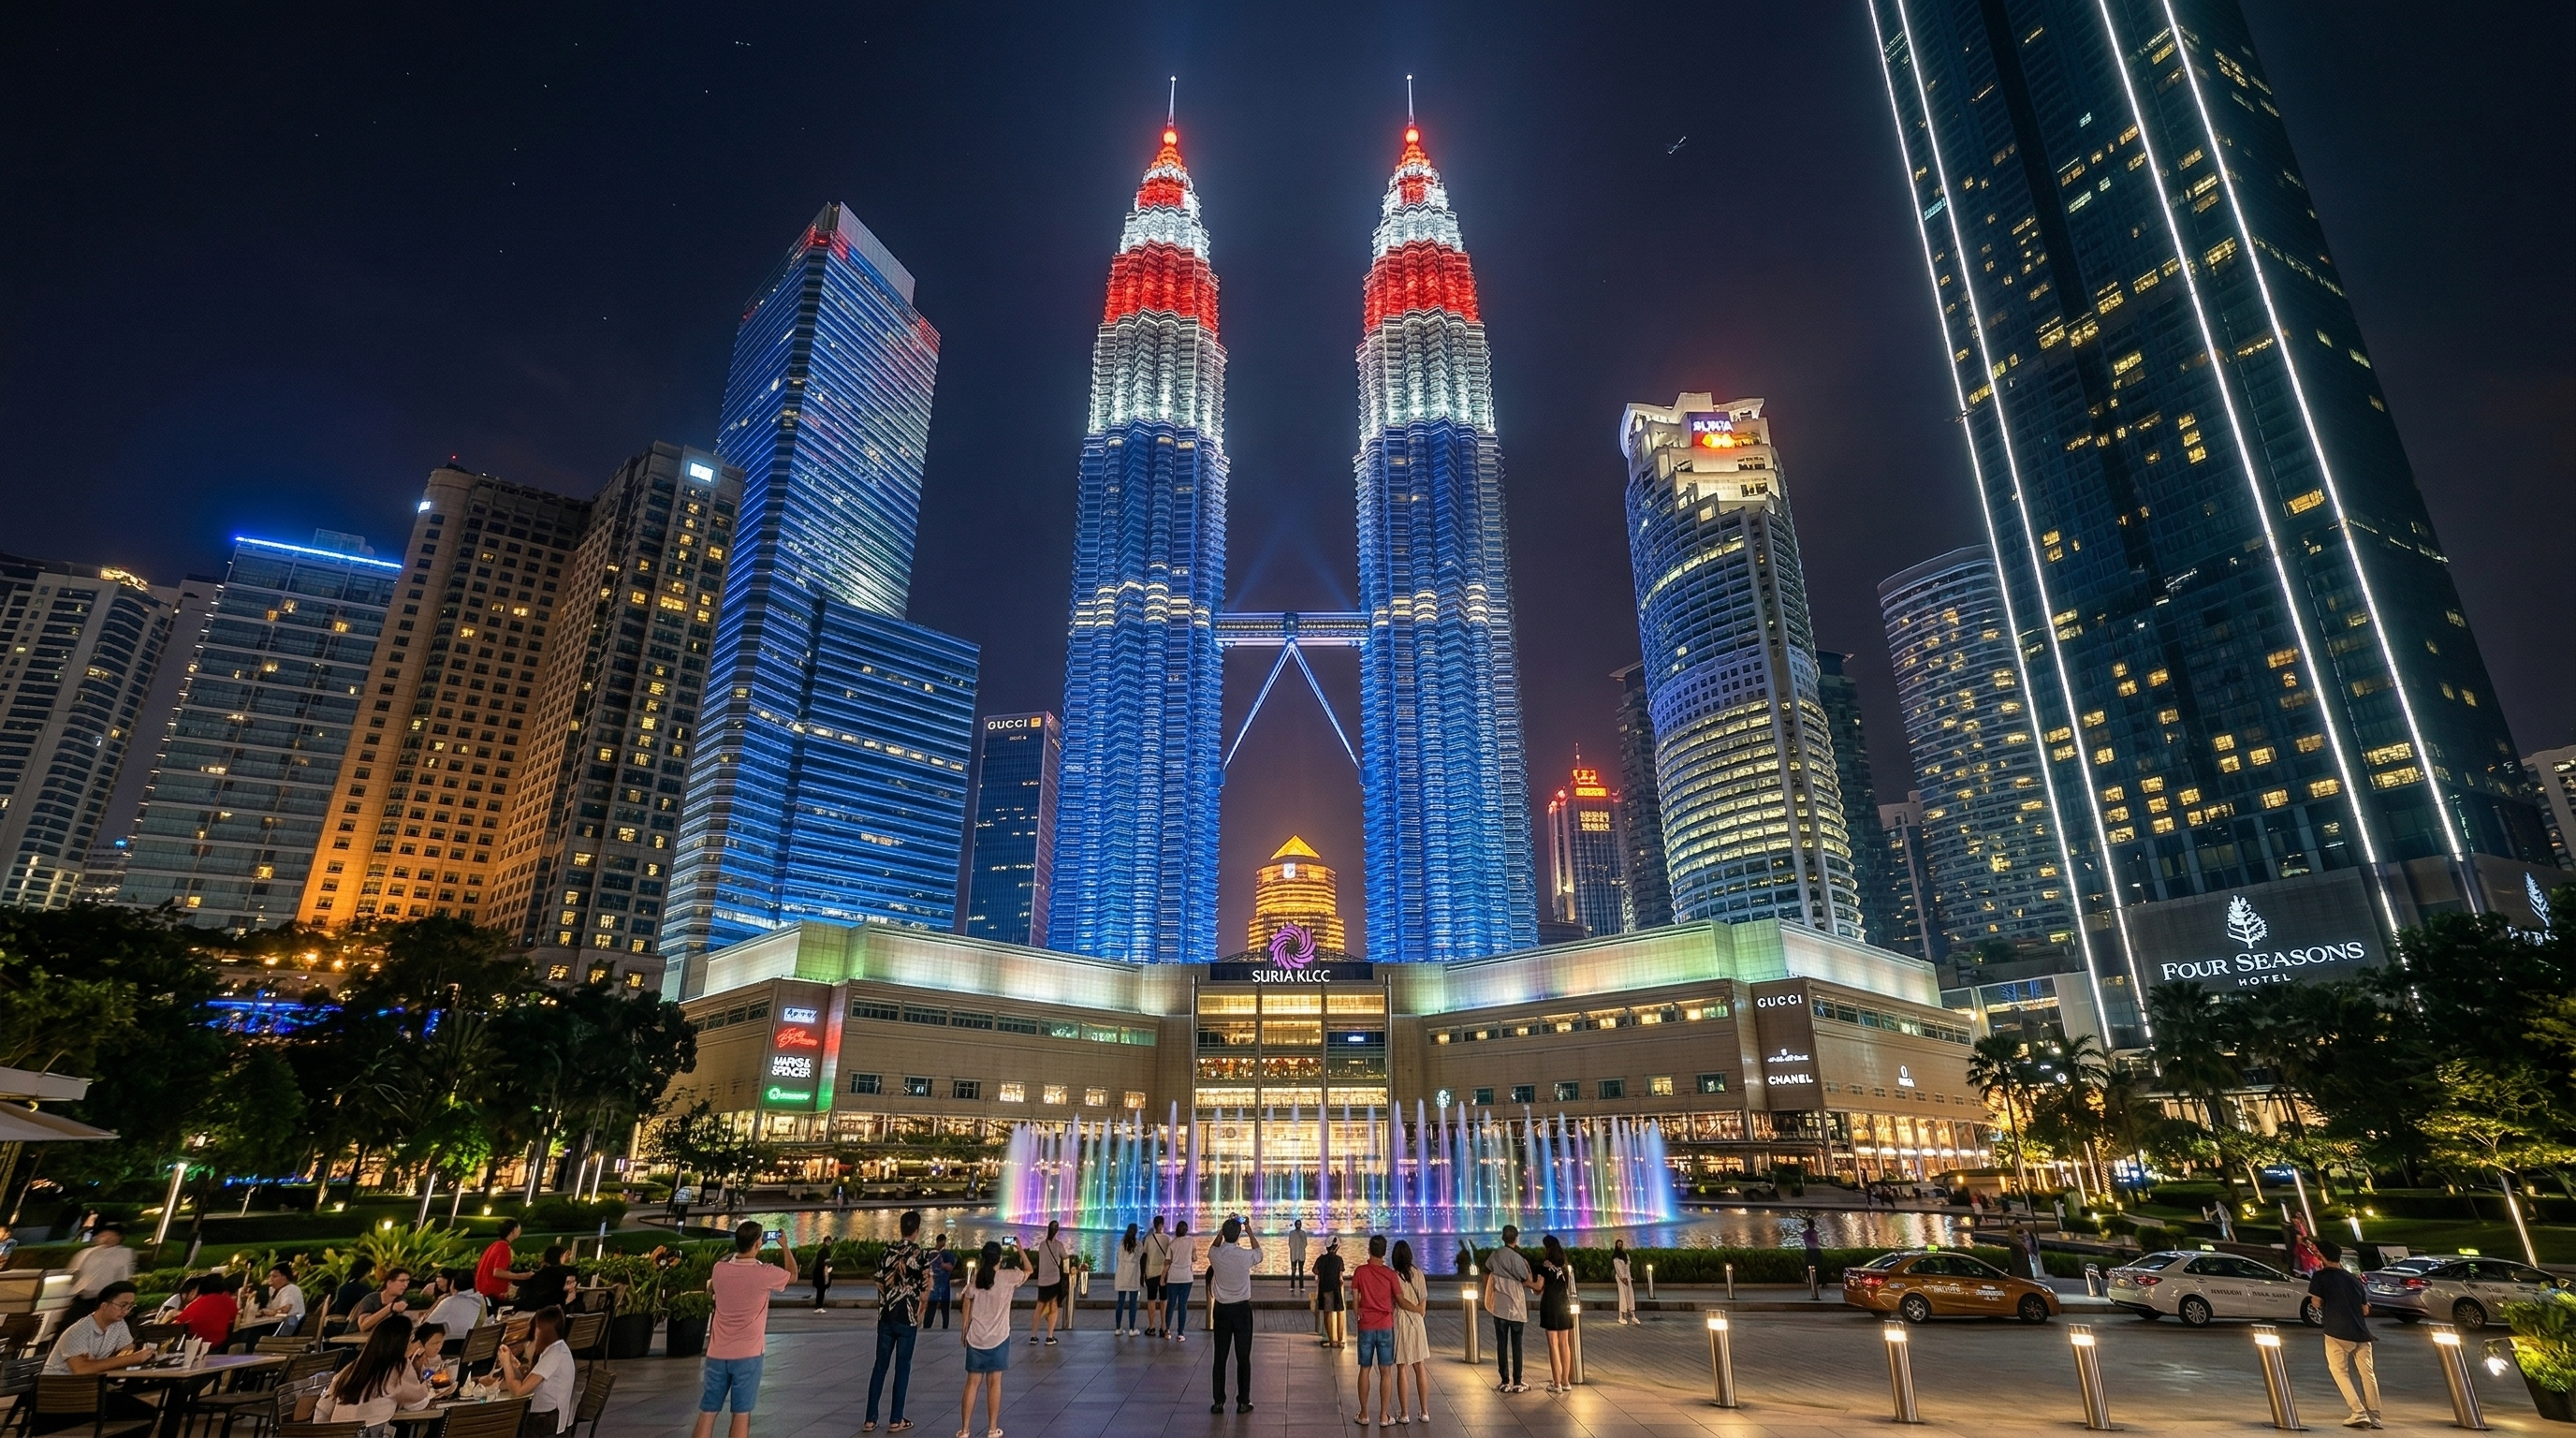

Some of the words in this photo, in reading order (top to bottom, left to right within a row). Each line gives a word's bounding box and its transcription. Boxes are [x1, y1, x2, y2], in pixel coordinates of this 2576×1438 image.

[988, 718, 1028, 730] GUCCI
[2160, 958, 2231, 981] FOUR
[2234, 941, 2364, 973] SEASONS
[1251, 970, 1295, 983] SURIA
[1296, 970, 1331, 983] KLCC
[2237, 972, 2291, 987] HOTEL
[1757, 993, 1803, 1008] GUCCI
[1767, 1074, 1814, 1086] CHANEL
